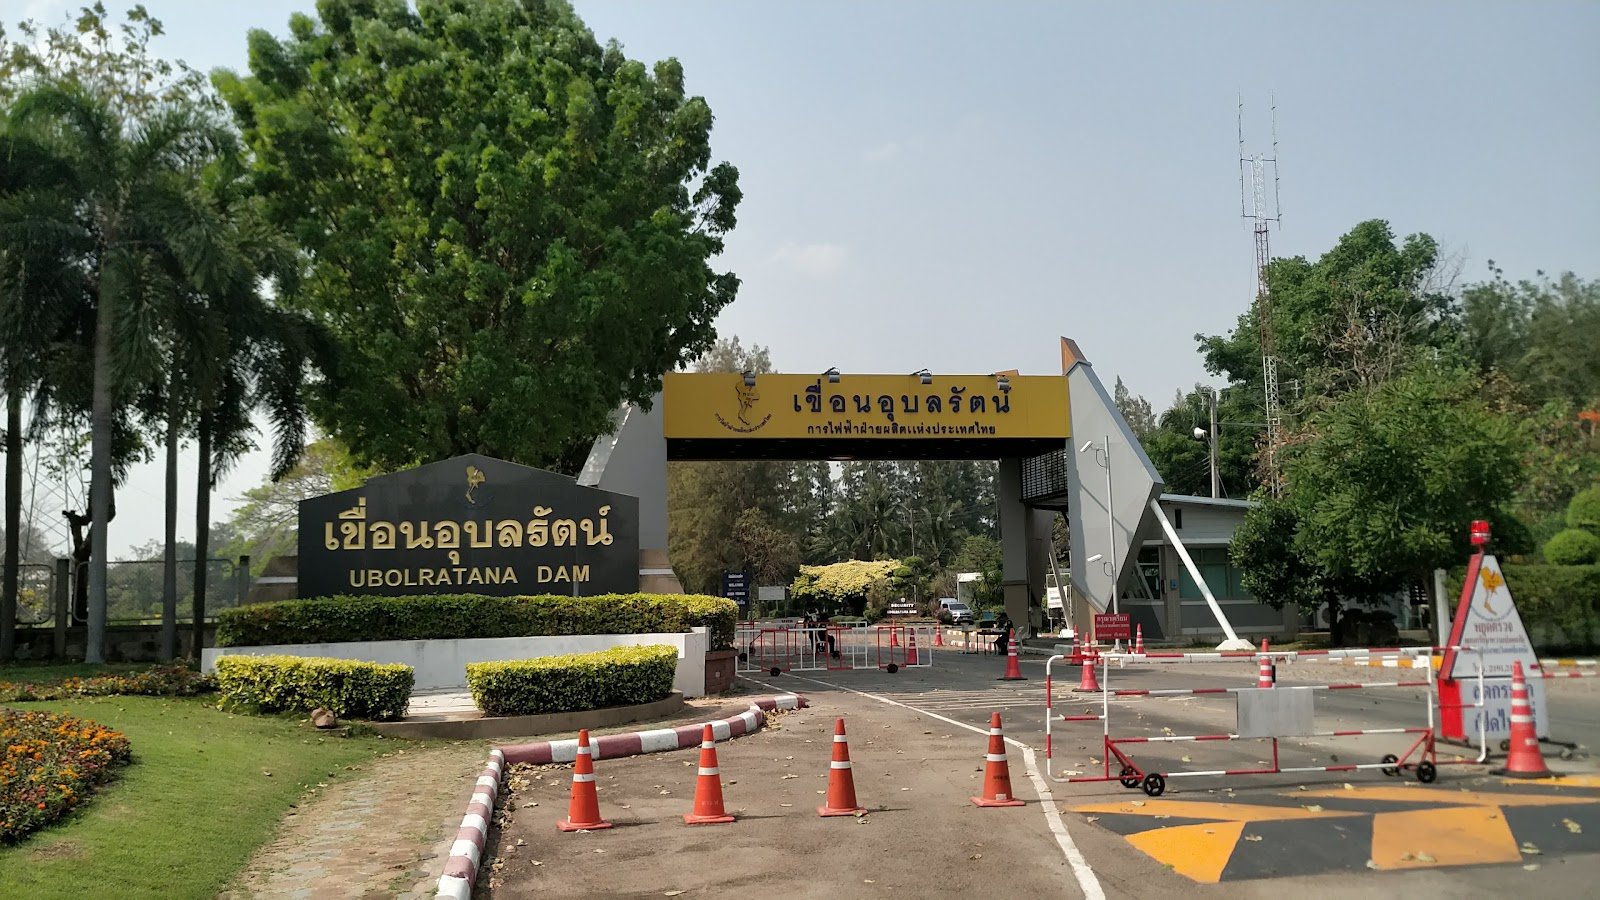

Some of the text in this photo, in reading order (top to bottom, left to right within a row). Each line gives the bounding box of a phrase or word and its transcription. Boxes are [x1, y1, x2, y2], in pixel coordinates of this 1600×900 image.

[793, 379, 1011, 421] เขื่อนอุบลรัตน์
[807, 420, 996, 435] การไฟฟ้าฝ่ายผลิตแห่งประเทศไทย
[325, 496, 614, 565] เขื่อนอุบลรัตน์
[350, 565, 590, 587] UBOLRATANA DAM
